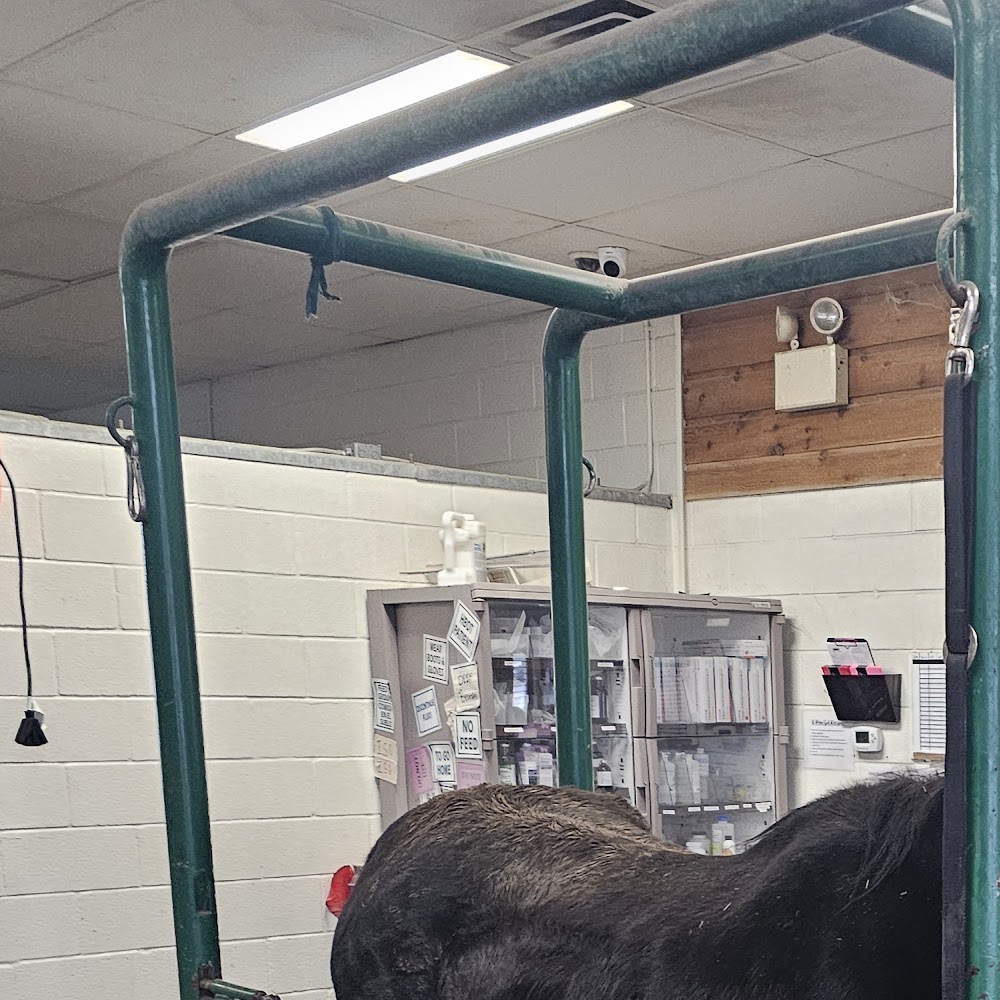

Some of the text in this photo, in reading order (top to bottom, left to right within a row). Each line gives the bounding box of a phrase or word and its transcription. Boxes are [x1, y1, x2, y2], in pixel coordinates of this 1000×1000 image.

[453, 625, 473, 652] PATIENT
[462, 720, 474, 732] NO
[460, 737, 479, 750] FEED
[435, 750, 450, 761] TO GO
[437, 765, 451, 775] HOME
